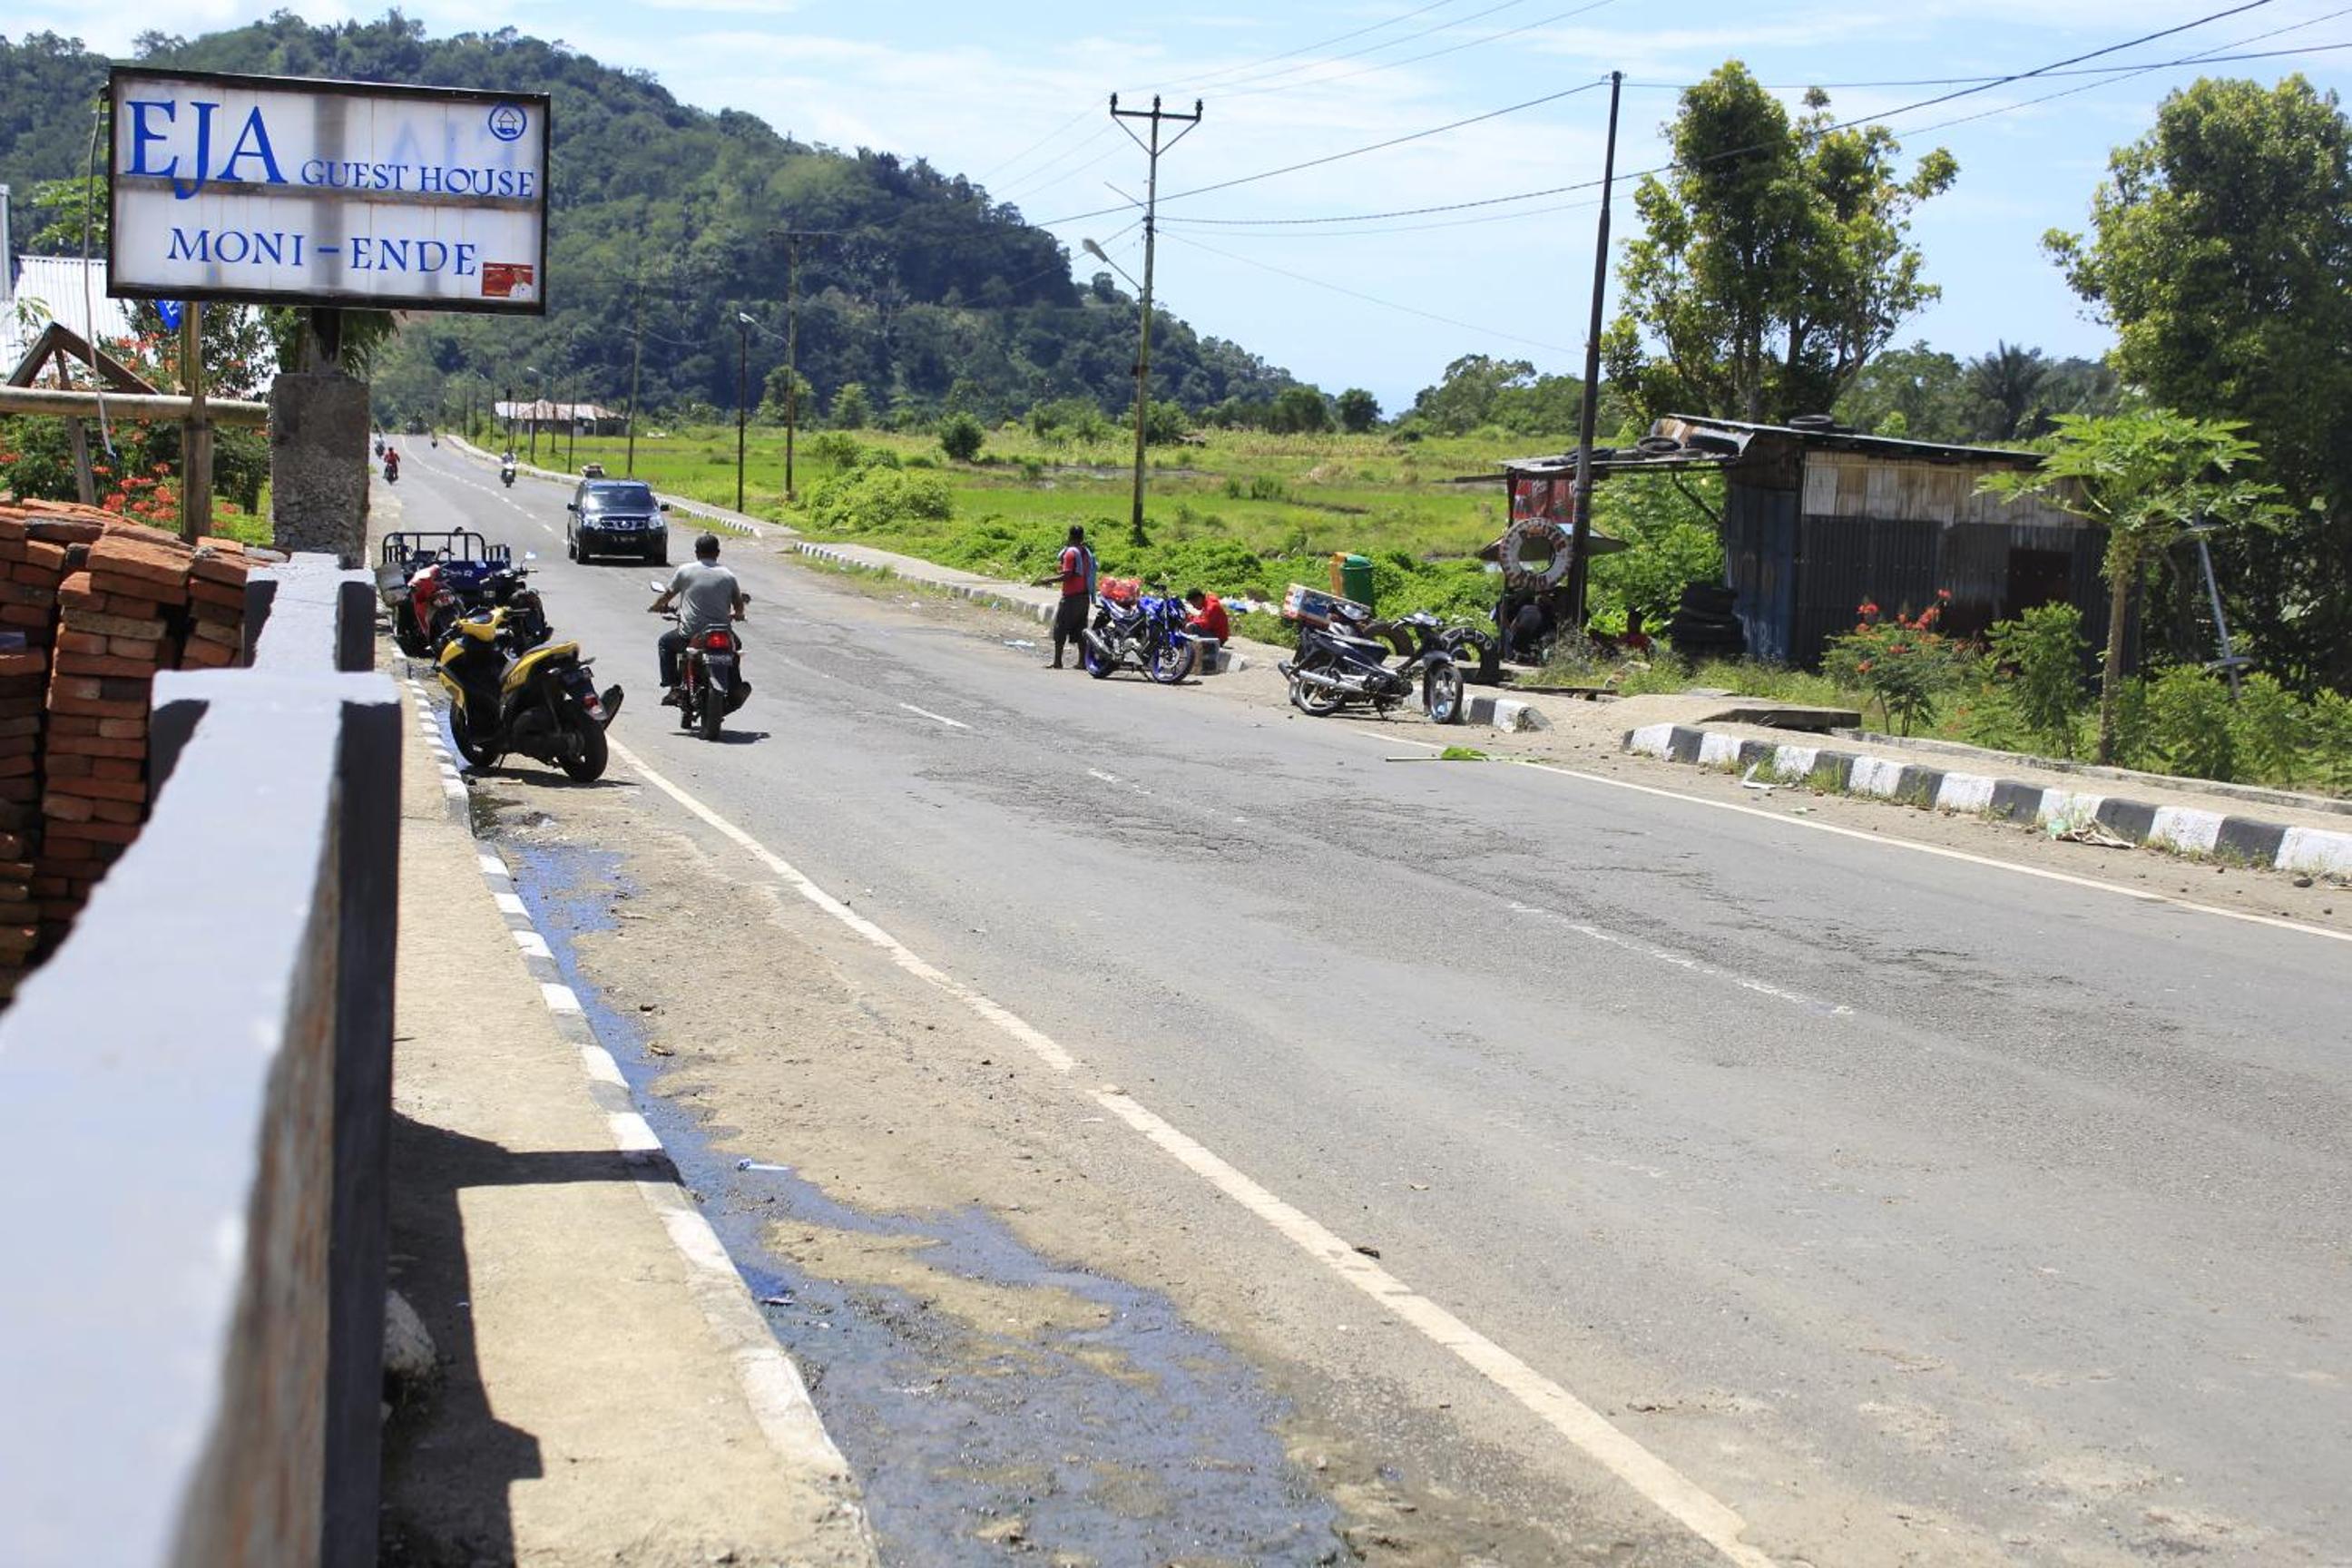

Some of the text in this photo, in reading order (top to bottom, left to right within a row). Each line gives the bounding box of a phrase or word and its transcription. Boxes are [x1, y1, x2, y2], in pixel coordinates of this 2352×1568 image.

[125, 100, 534, 200] EJA GUEST HOUSE
[167, 228, 305, 266] MONI
[350, 237, 476, 276] ENDE
